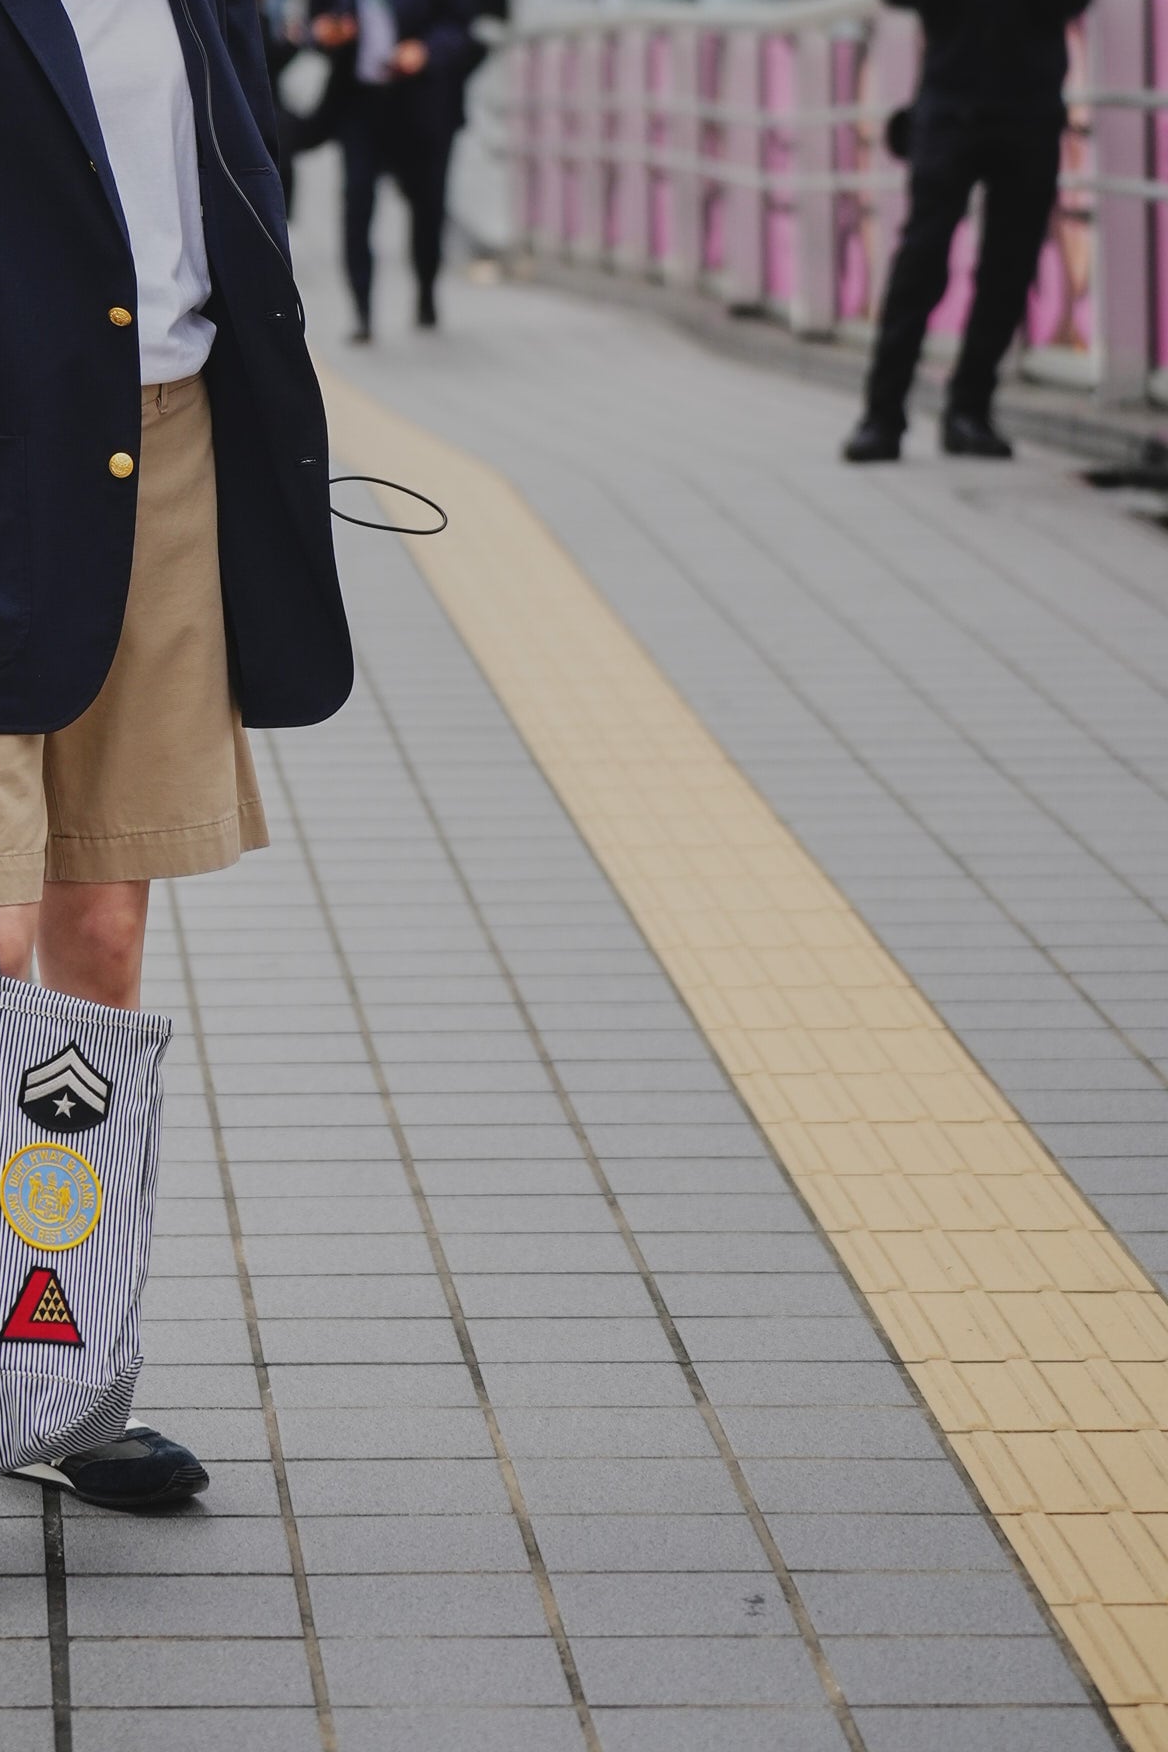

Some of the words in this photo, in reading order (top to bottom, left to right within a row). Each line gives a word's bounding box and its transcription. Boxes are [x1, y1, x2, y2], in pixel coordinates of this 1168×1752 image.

[66, 1158, 77, 1171] &
[37, 1227, 62, 1244] REST
[65, 1214, 89, 1240] STOP
